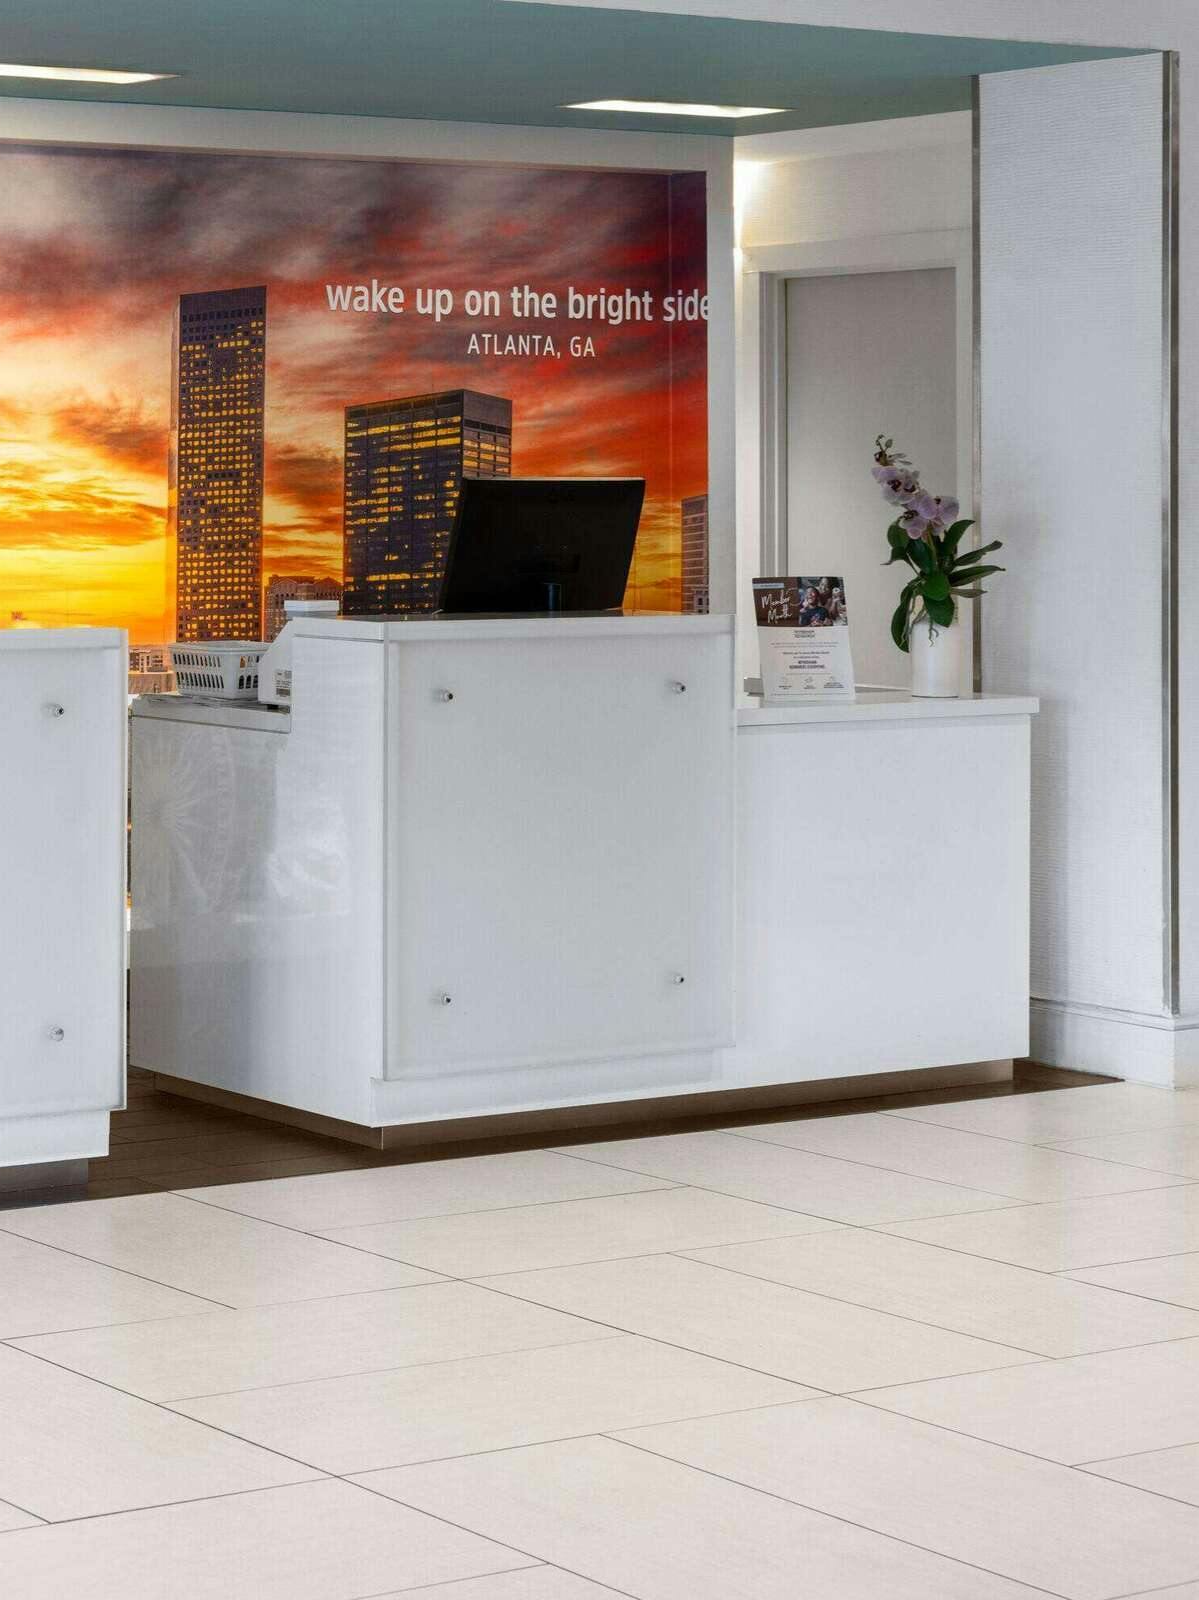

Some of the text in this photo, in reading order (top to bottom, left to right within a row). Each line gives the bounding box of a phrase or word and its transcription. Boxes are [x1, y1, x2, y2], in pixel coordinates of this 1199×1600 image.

[326, 279, 710, 325] wake up on the bright side
[467, 333, 596, 359] ATLANTA, GA
